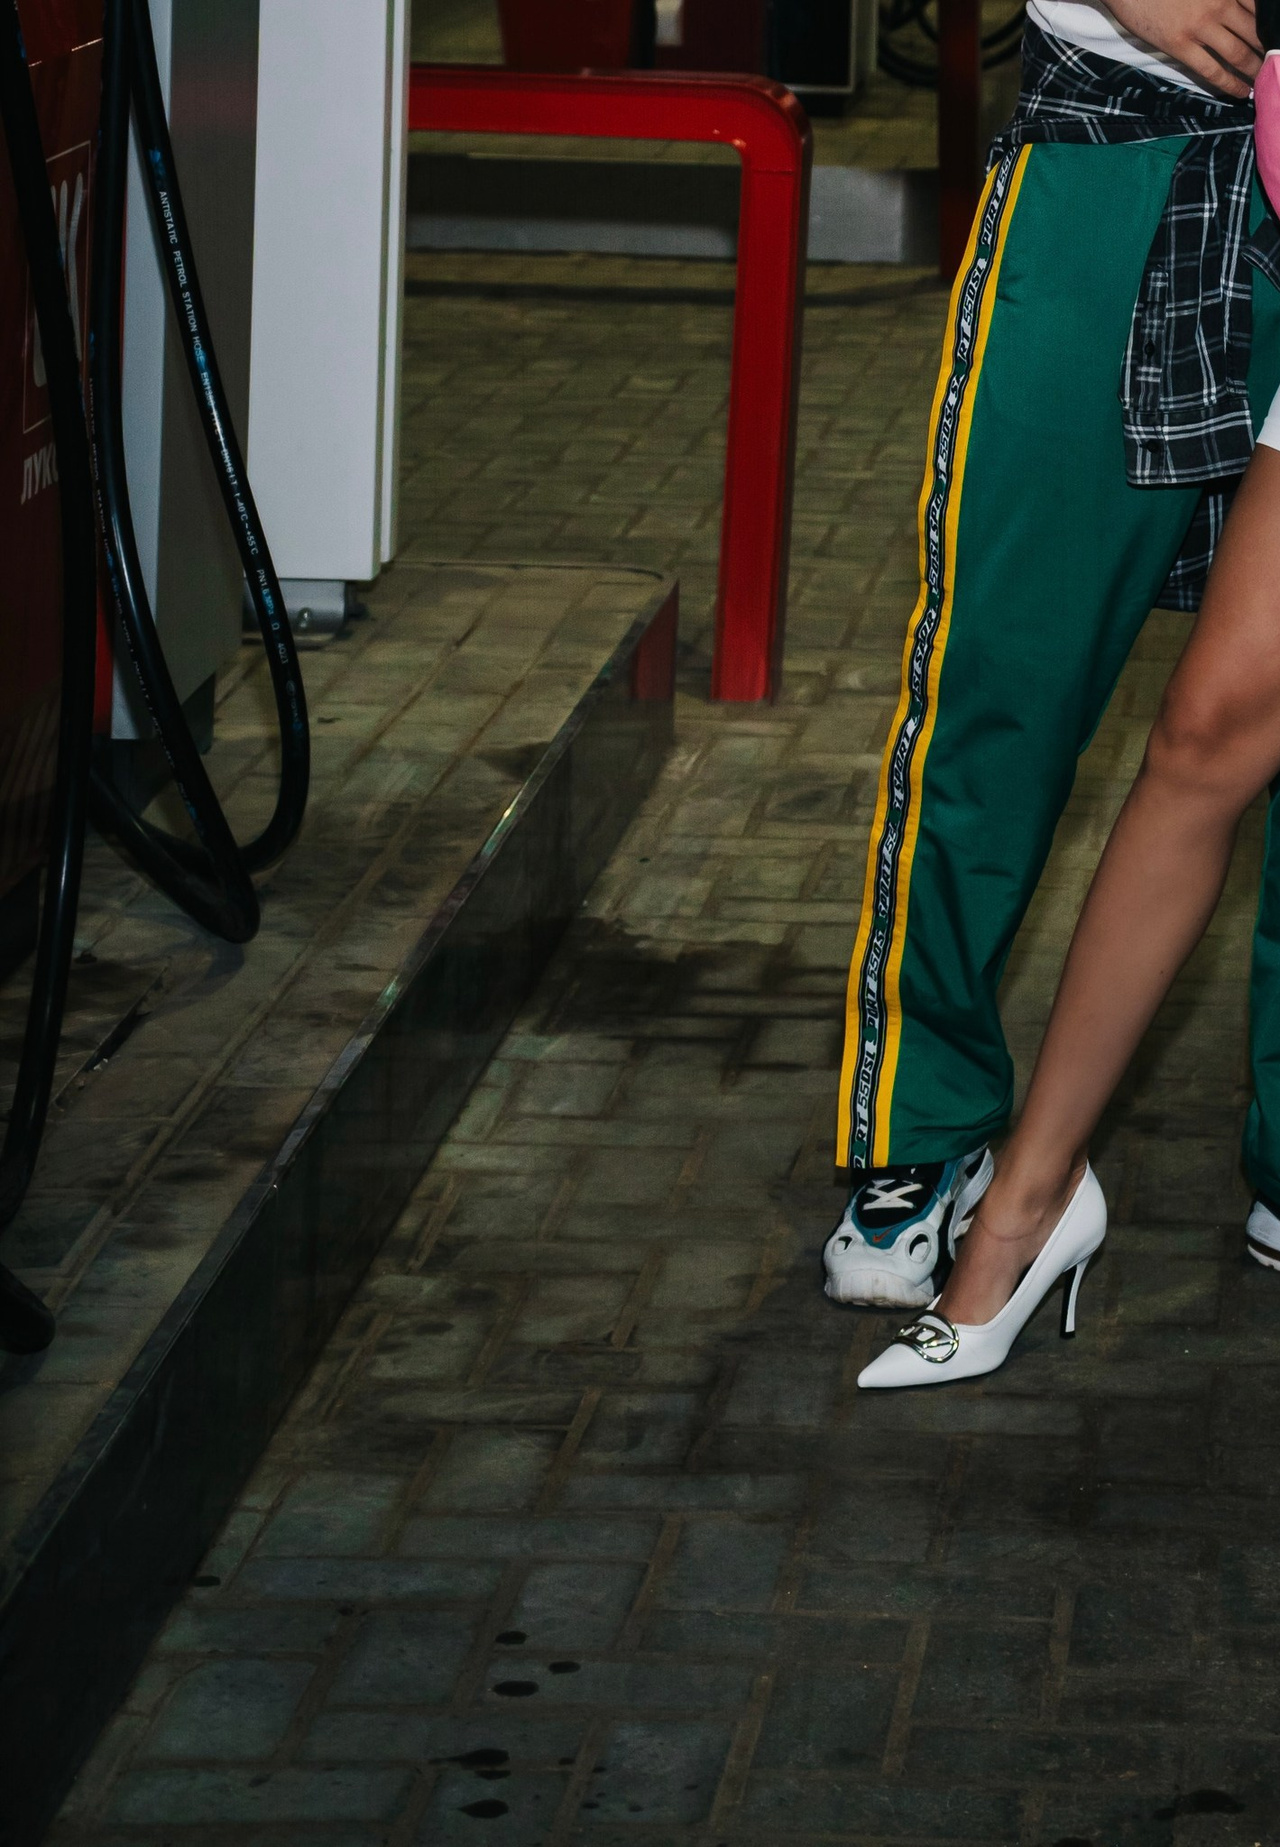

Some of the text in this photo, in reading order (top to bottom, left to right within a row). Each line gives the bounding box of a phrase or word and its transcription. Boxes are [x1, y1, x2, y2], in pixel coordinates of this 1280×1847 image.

[158, 190, 178, 244] ANTISTATIC
[171, 249, 188, 287] PETROL
[180, 291, 198, 332] STATION
